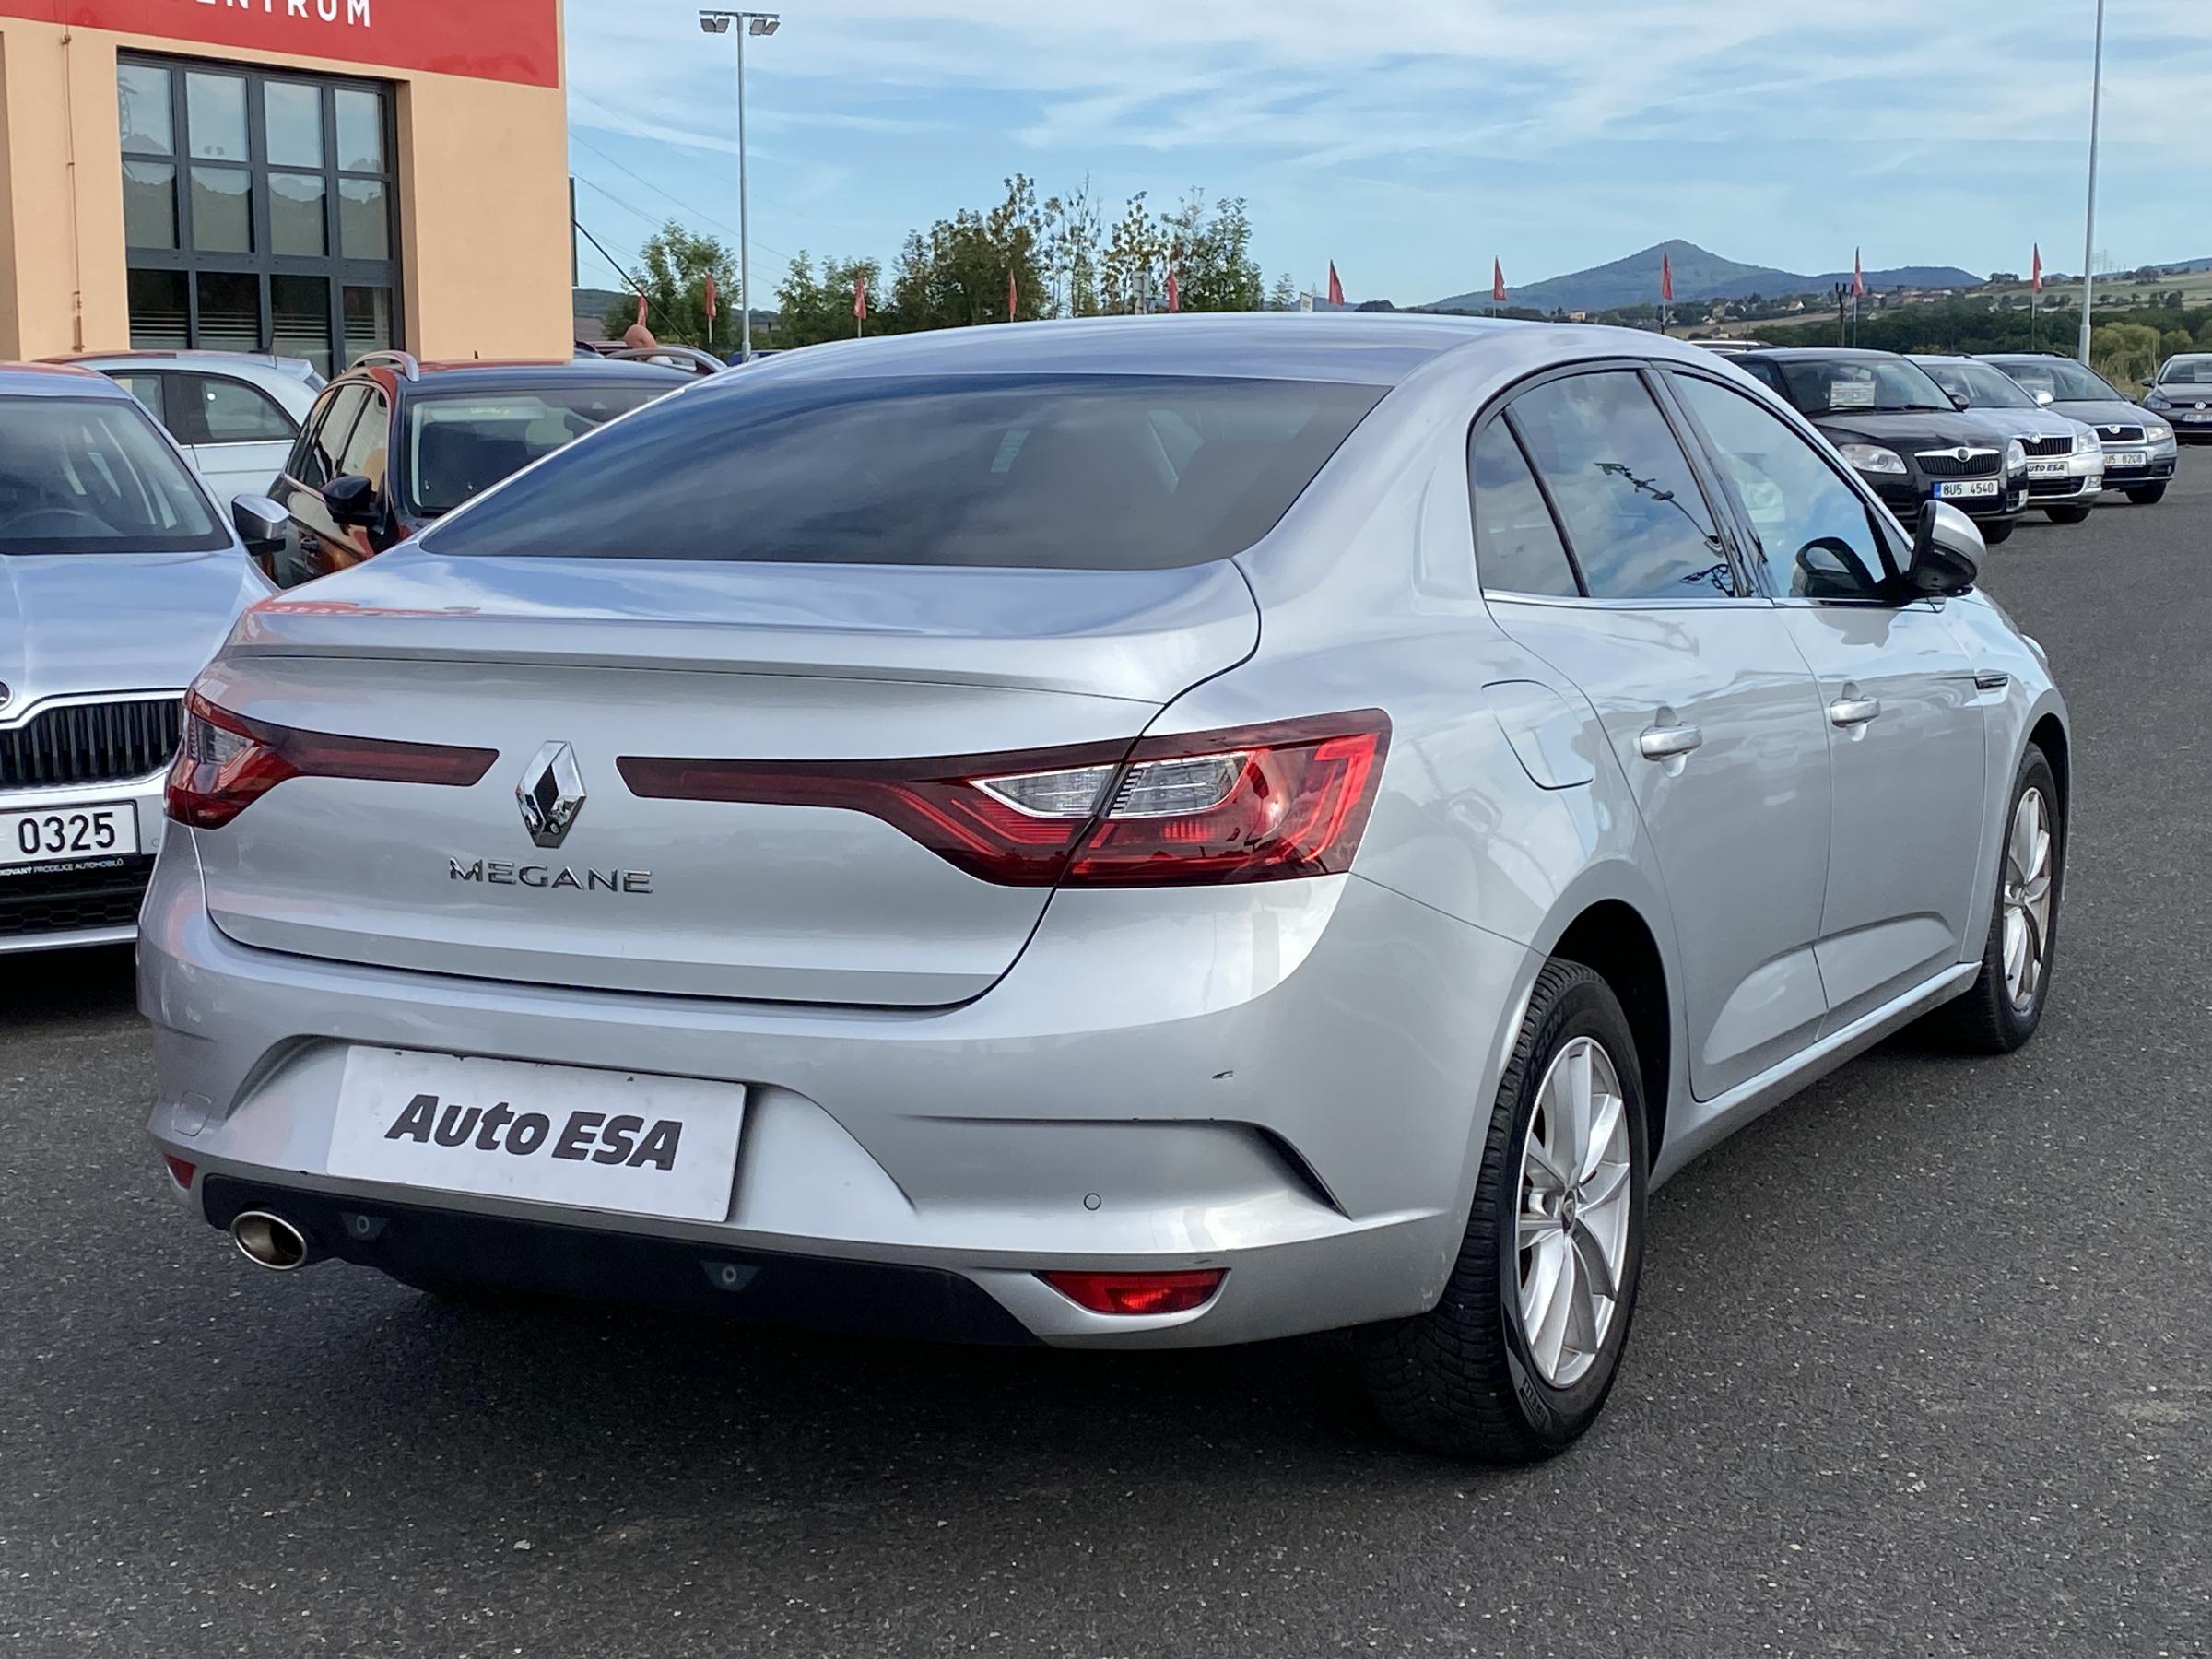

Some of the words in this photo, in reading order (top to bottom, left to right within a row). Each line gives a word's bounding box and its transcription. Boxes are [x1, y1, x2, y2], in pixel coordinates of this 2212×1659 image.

[196, 0, 371, 28] RUM
[2027, 464, 2046, 472] uto
[1943, 484, 1962, 496] 8U5
[1970, 482, 1994, 494] 4540
[18, 811, 116, 855] 0325
[33, 864, 73, 873] PRODEJCE
[449, 855, 653, 894] MEGANE
[384, 1093, 550, 1156] Auto
[551, 1110, 683, 1171] ESA
